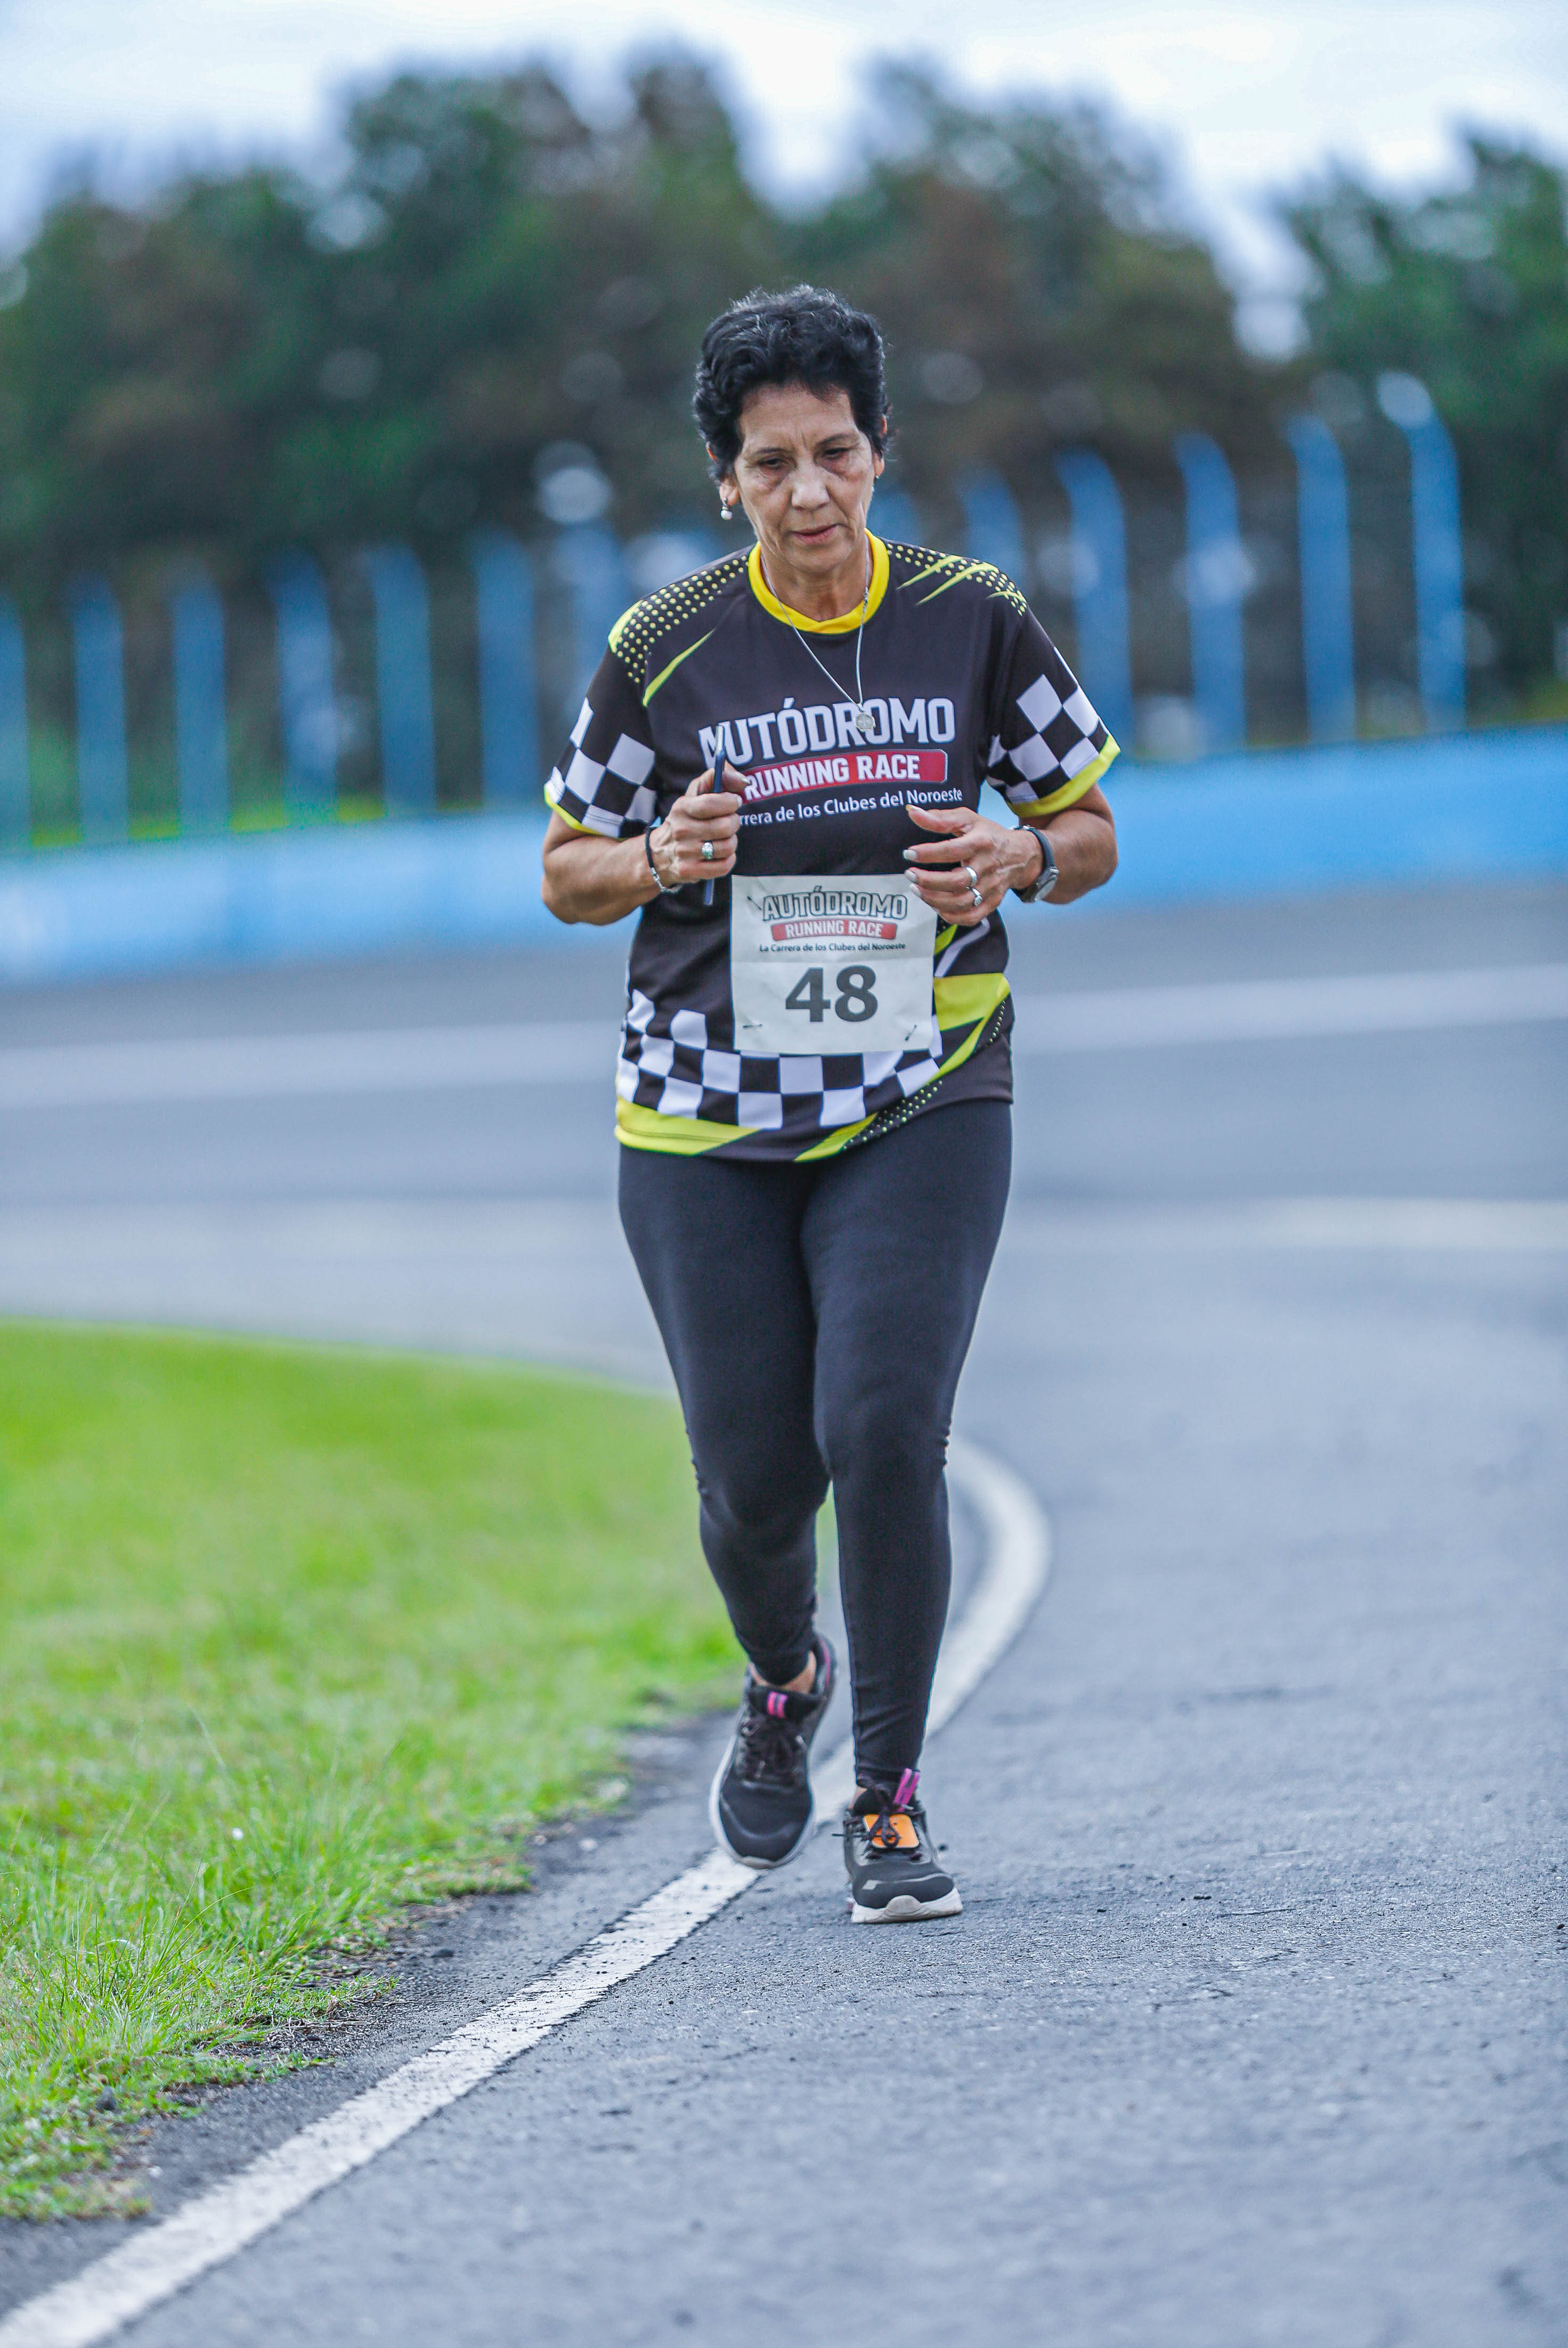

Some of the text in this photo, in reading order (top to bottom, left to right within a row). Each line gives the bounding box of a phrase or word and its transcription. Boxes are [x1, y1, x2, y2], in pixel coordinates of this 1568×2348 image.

[745, 754, 921, 800] RUNNING RACE
[740, 787, 963, 825] rrera de los Clubes del Noroeste
[762, 885, 908, 921] AUTÓDROMO
[770, 944, 801, 952] Carrera
[802, 943, 814, 951] de
[815, 943, 826, 951] los
[828, 942, 856, 951] Clubes
[858, 942, 871, 950] del
[872, 942, 906, 951] Noroeste
[784, 919, 883, 938] RUNNING RACE
[785, 965, 878, 1022] 48
